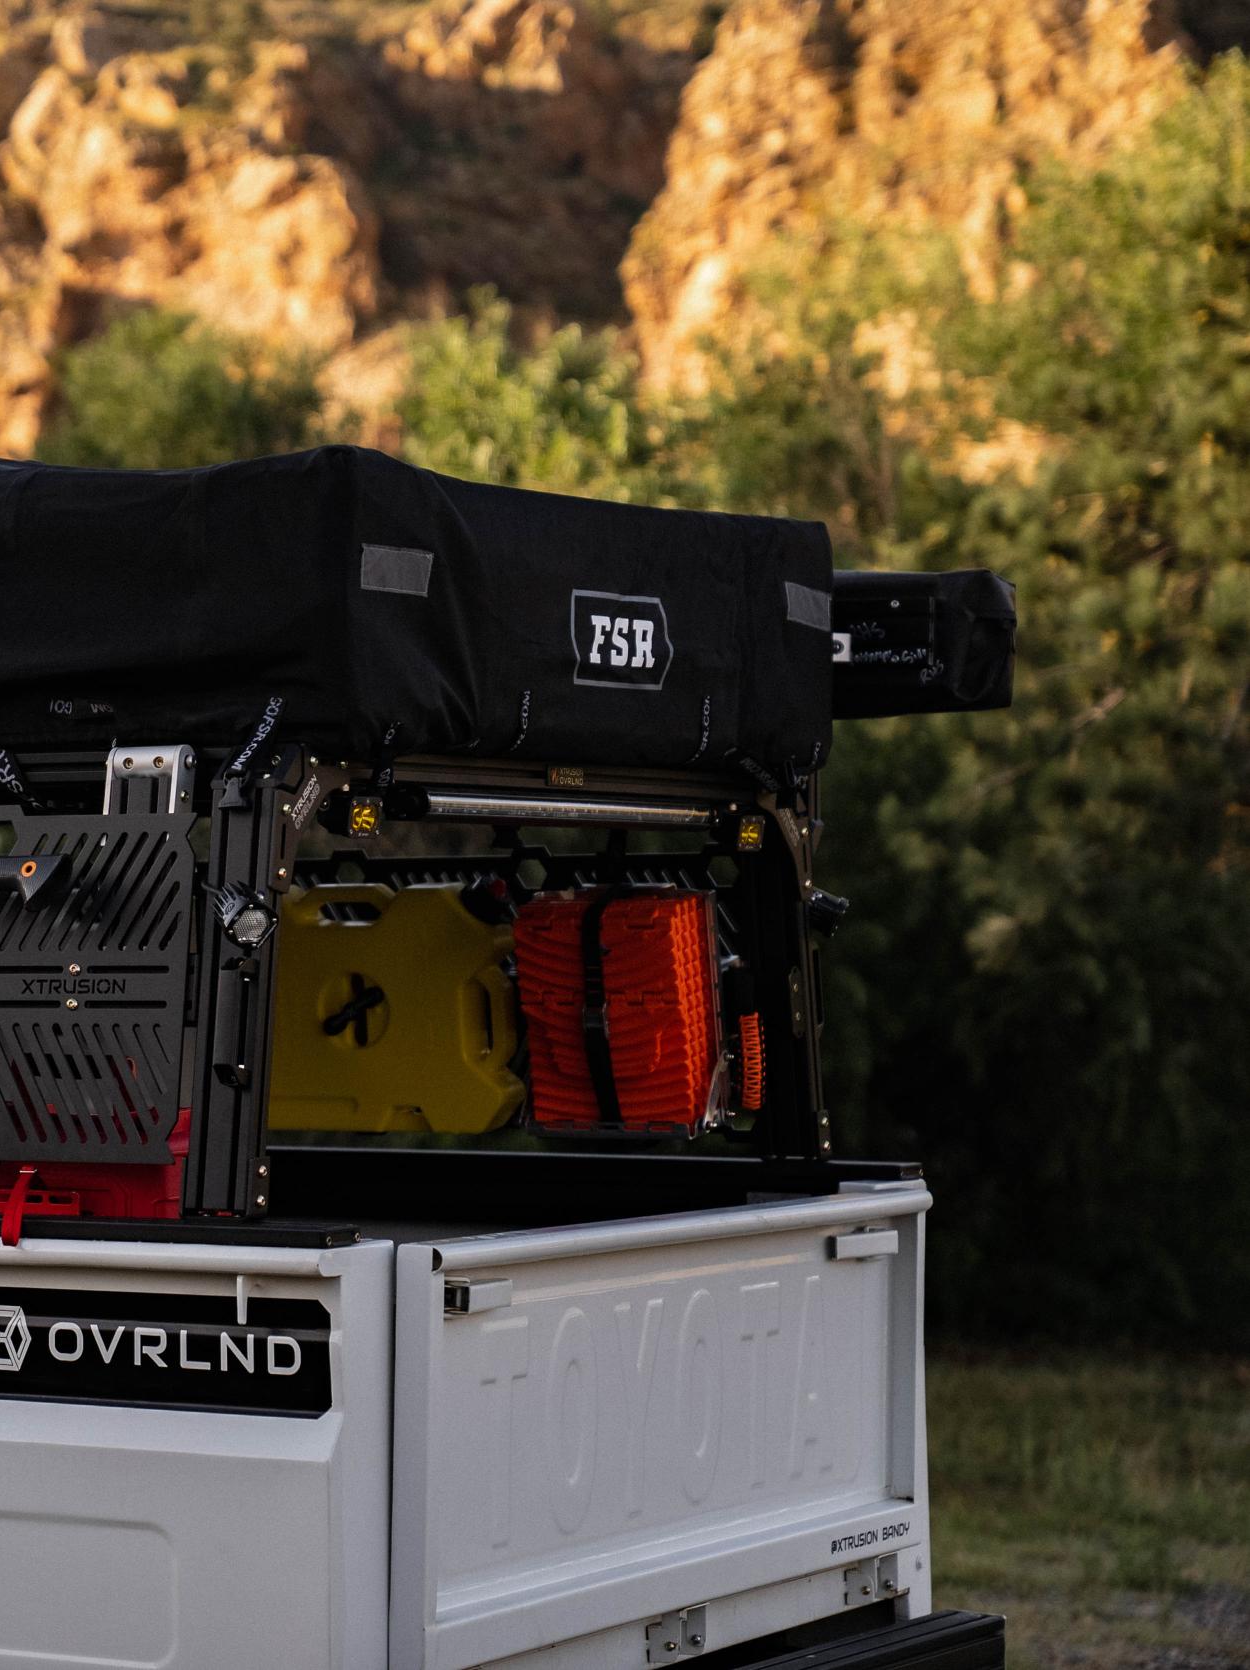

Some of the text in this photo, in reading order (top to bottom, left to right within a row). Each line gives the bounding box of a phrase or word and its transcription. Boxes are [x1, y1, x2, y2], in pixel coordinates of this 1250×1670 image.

[589, 614, 655, 669] FSR
[21, 979, 126, 994] XTRUSION
[48, 1322, 302, 1375] OVRLND
[882, 1521, 910, 1541] BANDY
